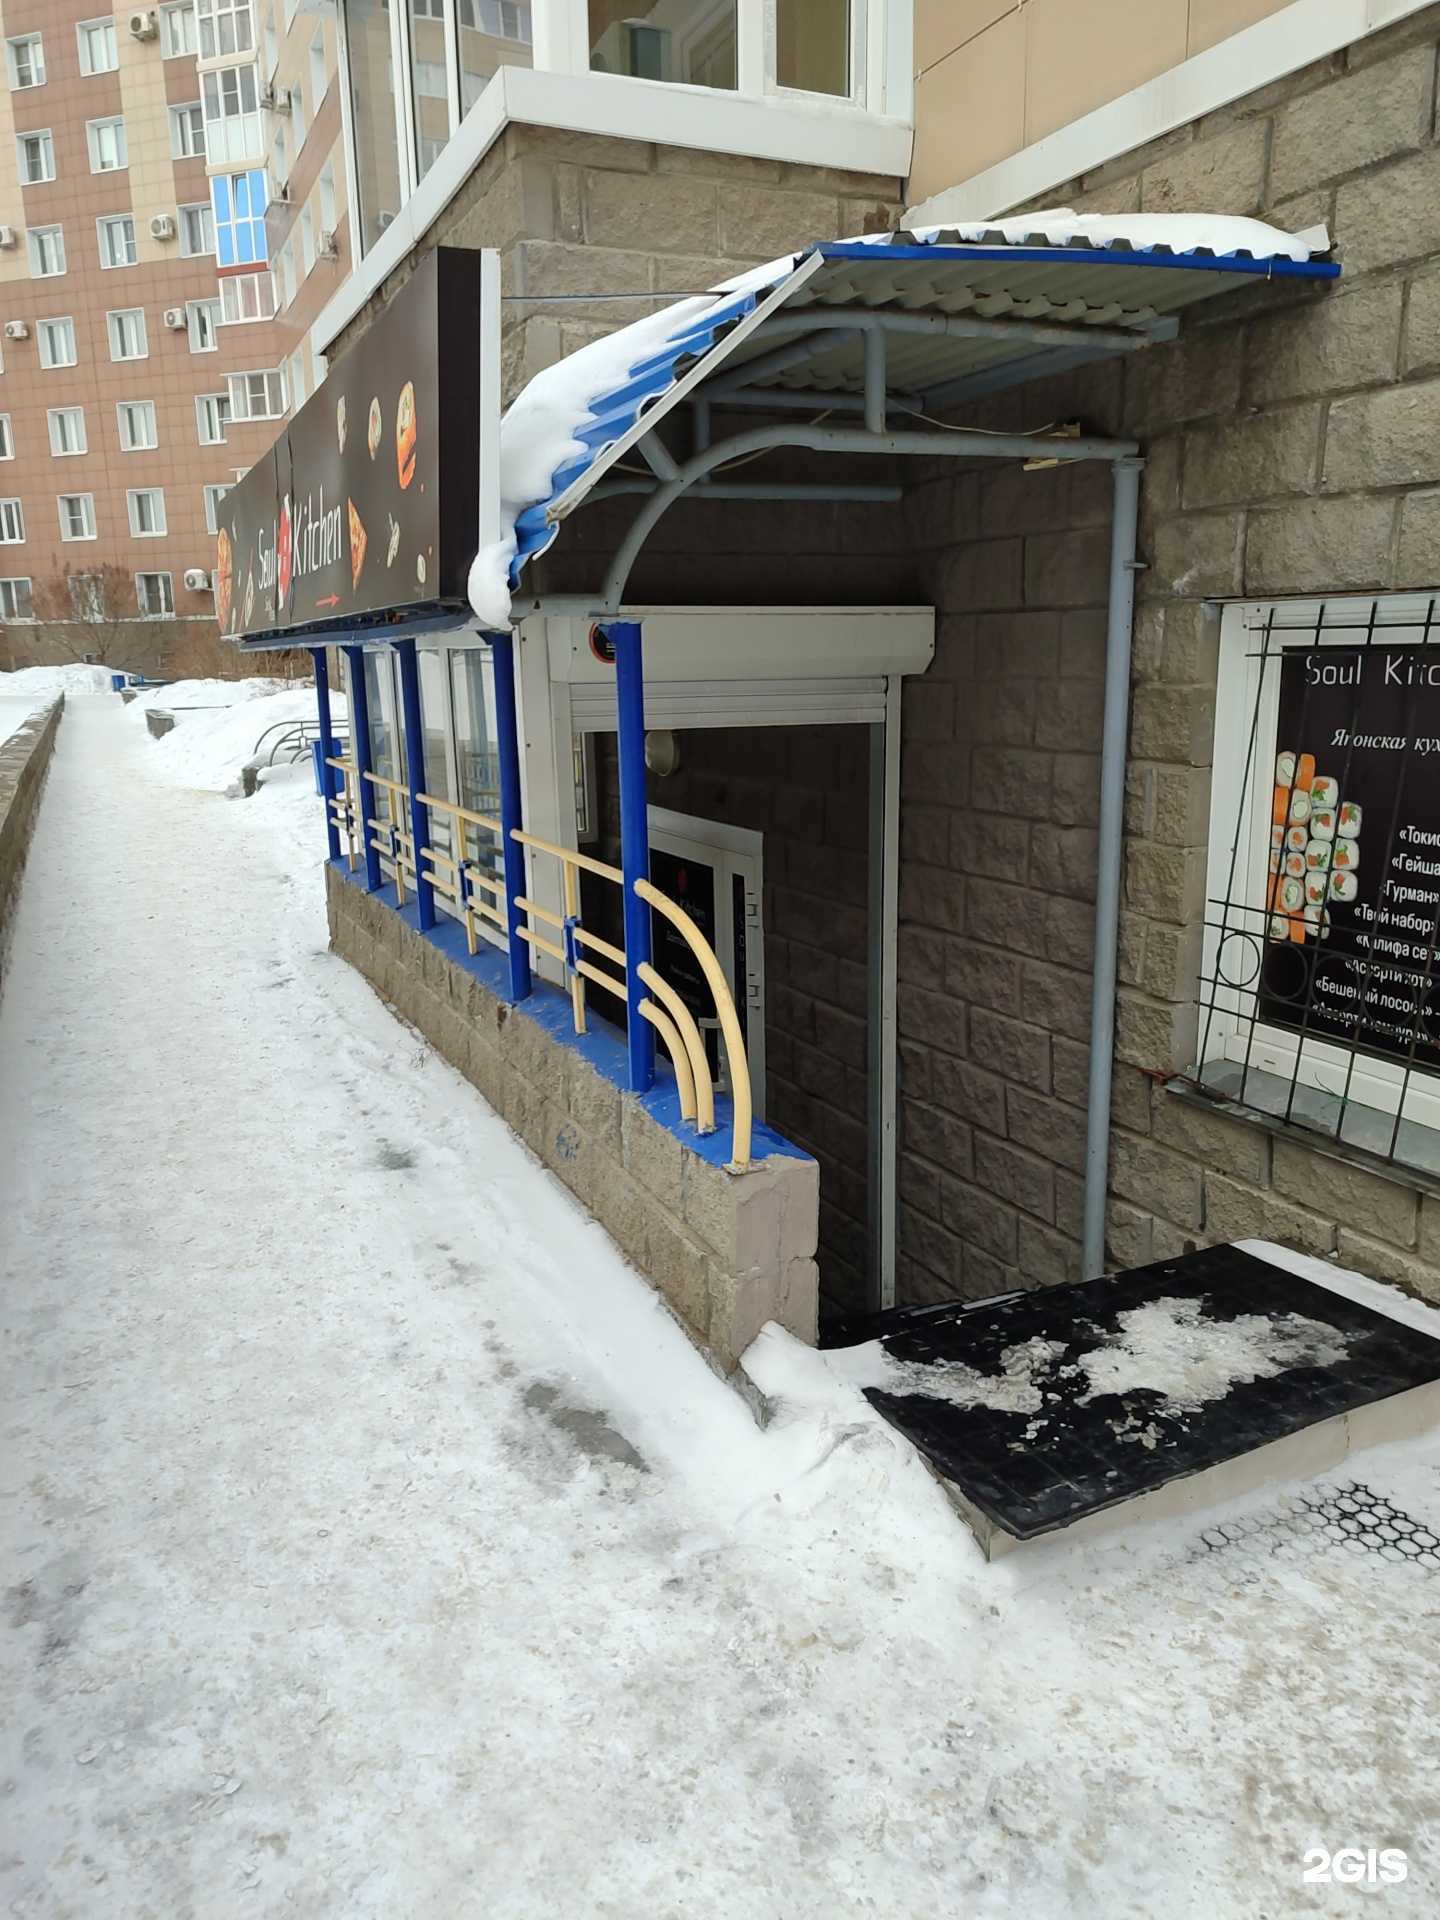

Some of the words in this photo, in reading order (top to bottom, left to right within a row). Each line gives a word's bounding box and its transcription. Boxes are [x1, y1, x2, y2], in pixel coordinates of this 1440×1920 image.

[258, 519, 277, 591] Soul
[292, 483, 342, 578] Kitchen
[1305, 655, 1361, 685] Soul
